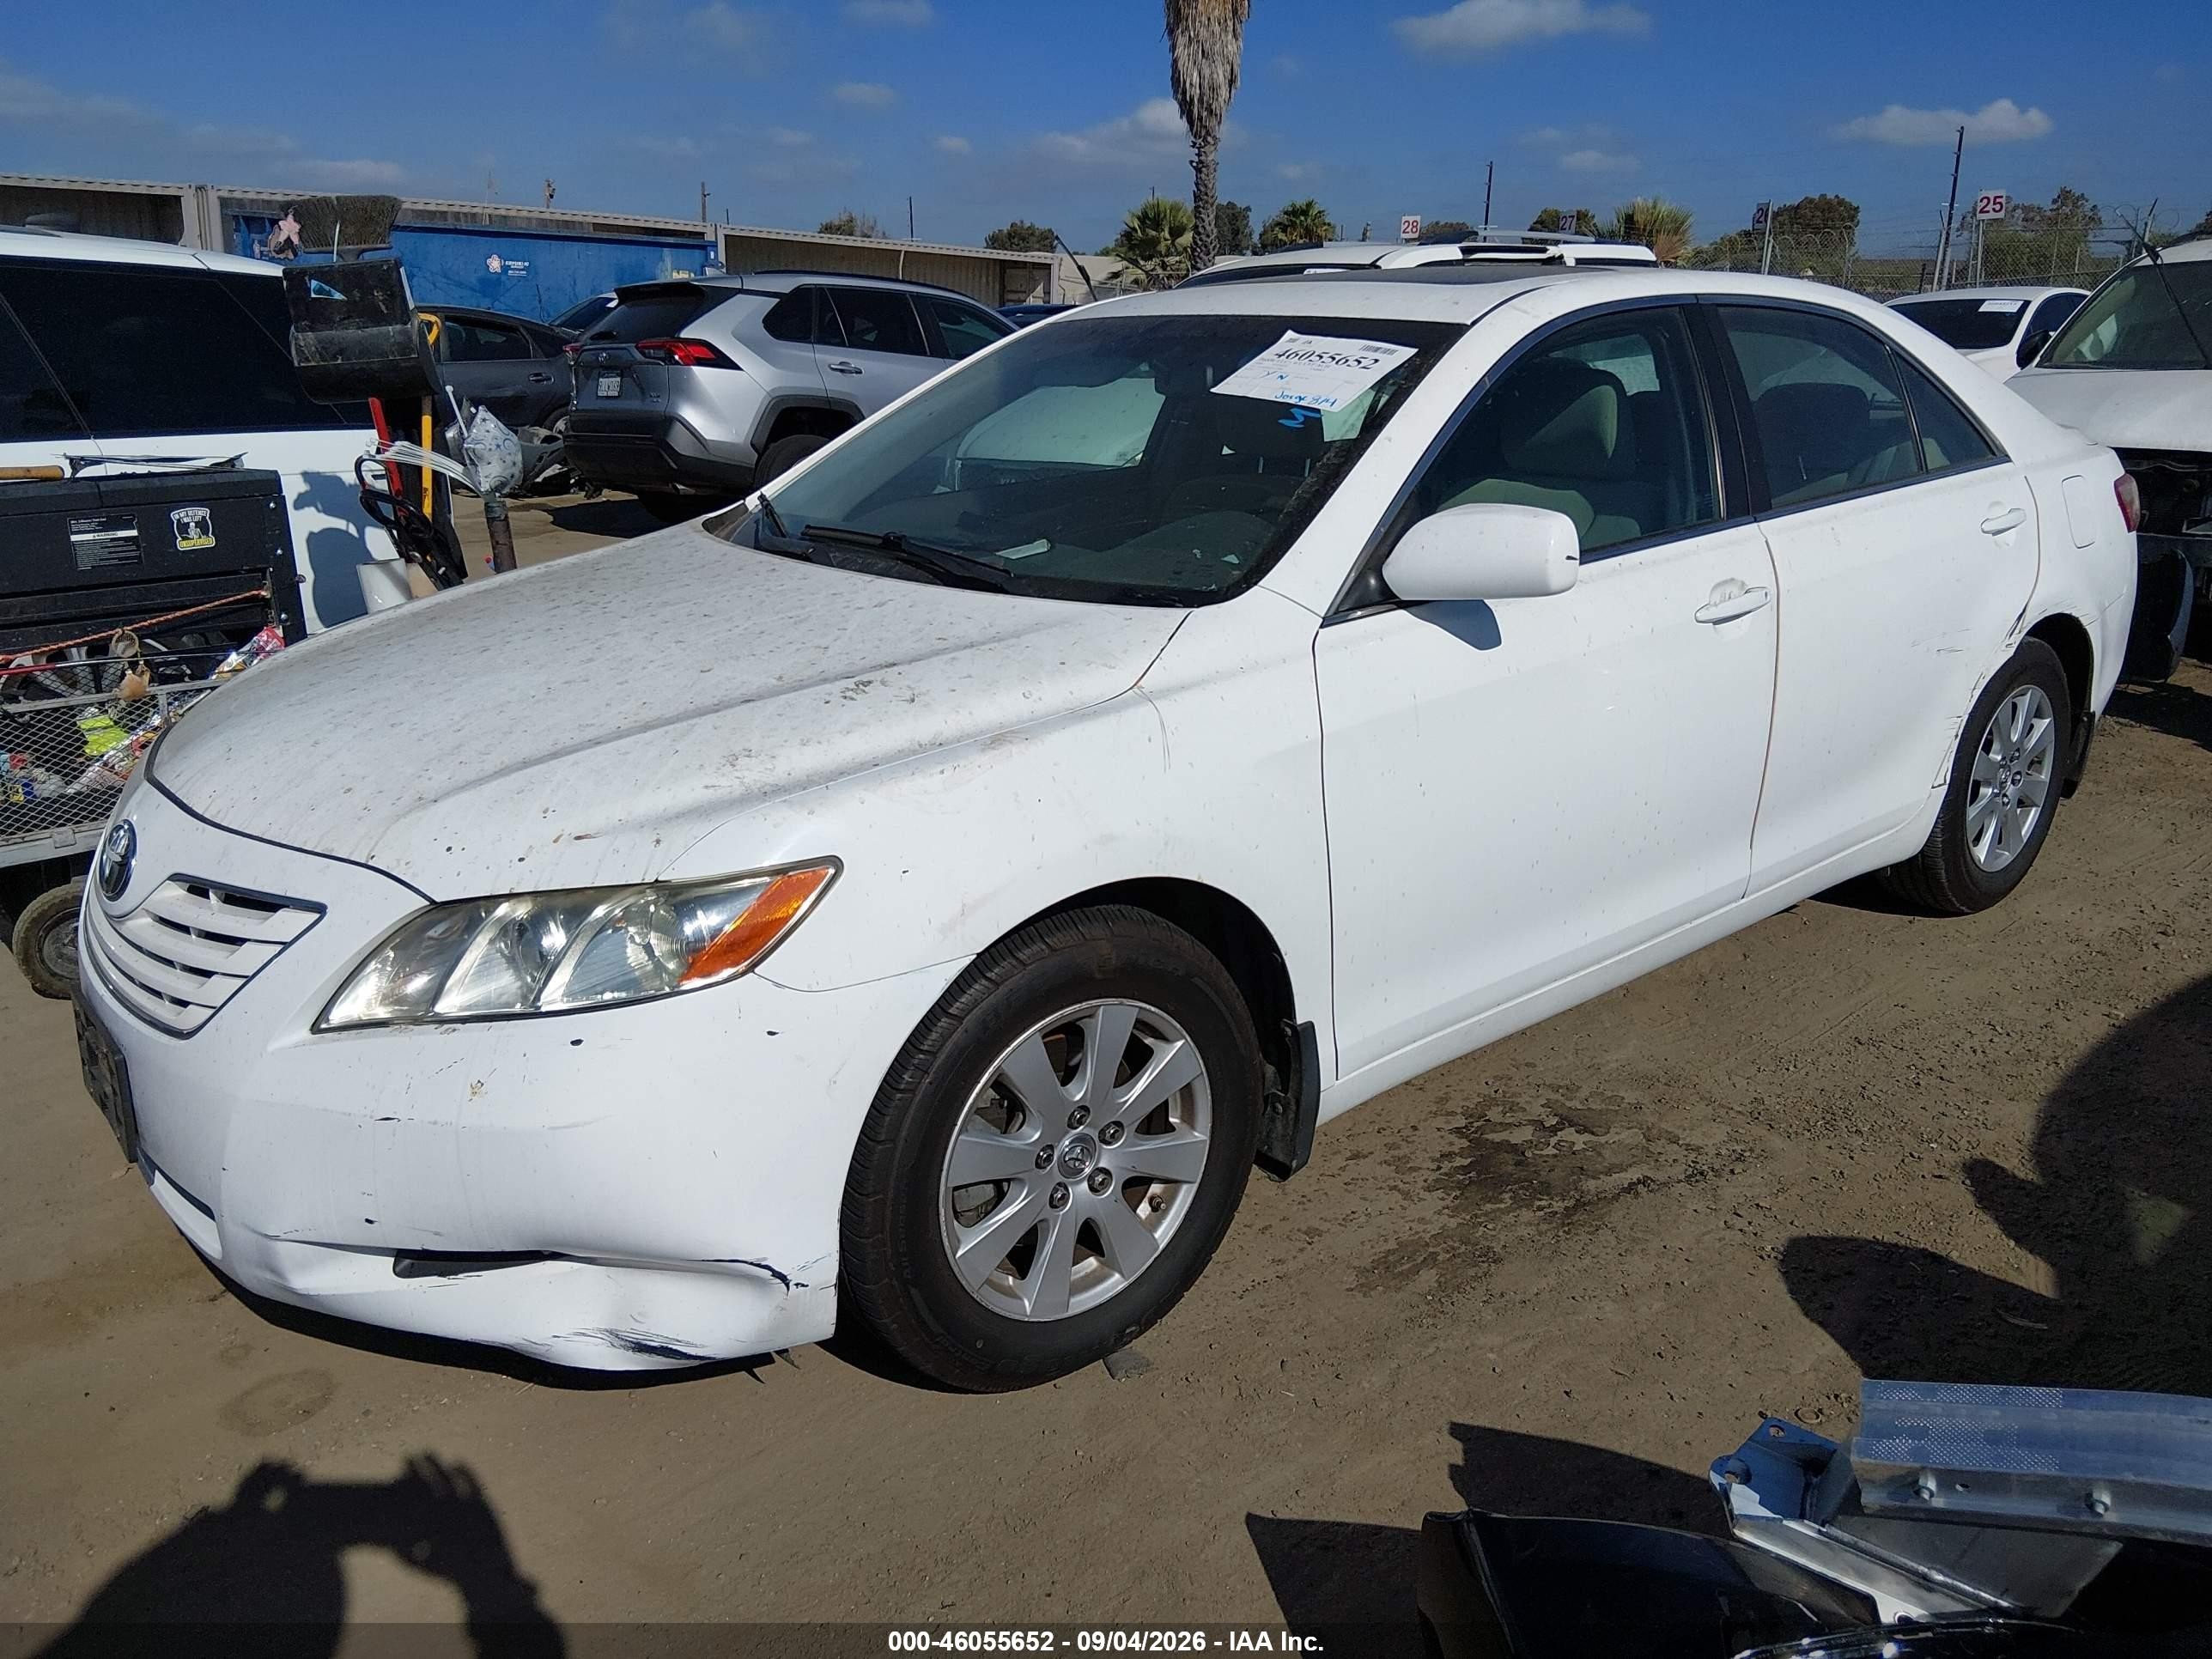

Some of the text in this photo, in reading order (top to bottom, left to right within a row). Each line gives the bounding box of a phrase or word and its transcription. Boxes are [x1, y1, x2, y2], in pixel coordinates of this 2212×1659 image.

[1978, 196, 2003, 214] 25
[1402, 220, 1419, 234] 28
[1559, 215, 1575, 231] 27
[1274, 348, 1381, 370] 46055652
